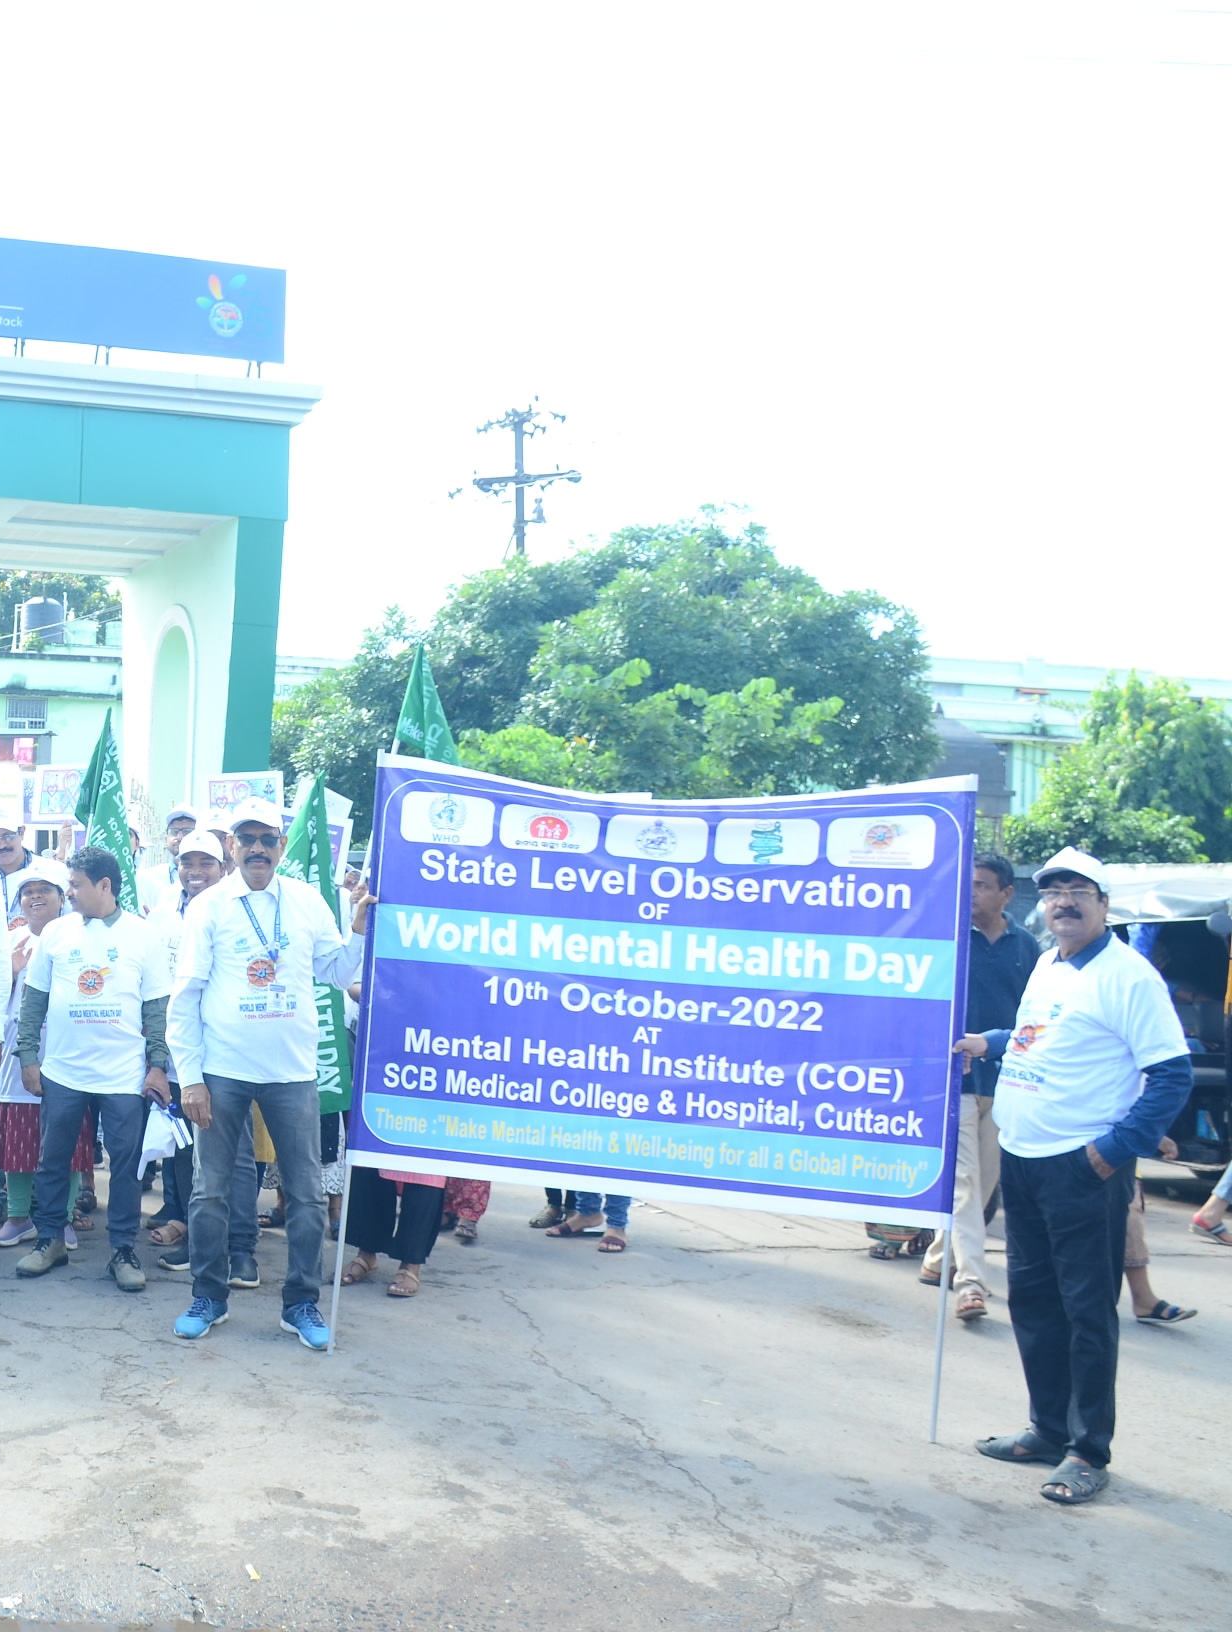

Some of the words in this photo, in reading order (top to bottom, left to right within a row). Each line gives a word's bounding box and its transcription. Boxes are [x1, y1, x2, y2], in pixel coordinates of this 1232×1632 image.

[432, 833, 460, 844] WHO
[420, 848, 517, 887] State
[530, 856, 636, 896] Level
[650, 865, 912, 909] Observation
[638, 901, 670, 920] OF
[395, 910, 518, 957] World
[530, 922, 672, 970] Mental
[685, 933, 831, 979] Health
[844, 942, 934, 993] Day
[483, 975, 549, 1007] 10th
[560, 982, 824, 1032] October-2022
[632, 1026, 662, 1044] AT
[317, 1047, 343, 1094] DAY
[404, 1027, 512, 1063] Mental
[522, 1038, 630, 1073] Health
[641, 1048, 785, 1087] Institute
[796, 1061, 905, 1103] (COE)
[383, 1063, 437, 1092] SCB
[445, 1069, 543, 1103] Medical
[550, 1079, 649, 1118] College
[657, 1089, 678, 1115] &
[685, 1092, 806, 1132] Hospital,
[814, 1102, 924, 1138] Cuttack
[375, 1106, 427, 1133] Theme
[492, 1120, 546, 1145] Mental
[550, 1125, 603, 1152] Health
[608, 1131, 619, 1153] &
[625, 1133, 714, 1168] Well-being
[719, 1142, 744, 1165] for
[749, 1146, 768, 1168] all
[774, 1153, 783, 1169] a
[789, 1148, 847, 1176] Global
